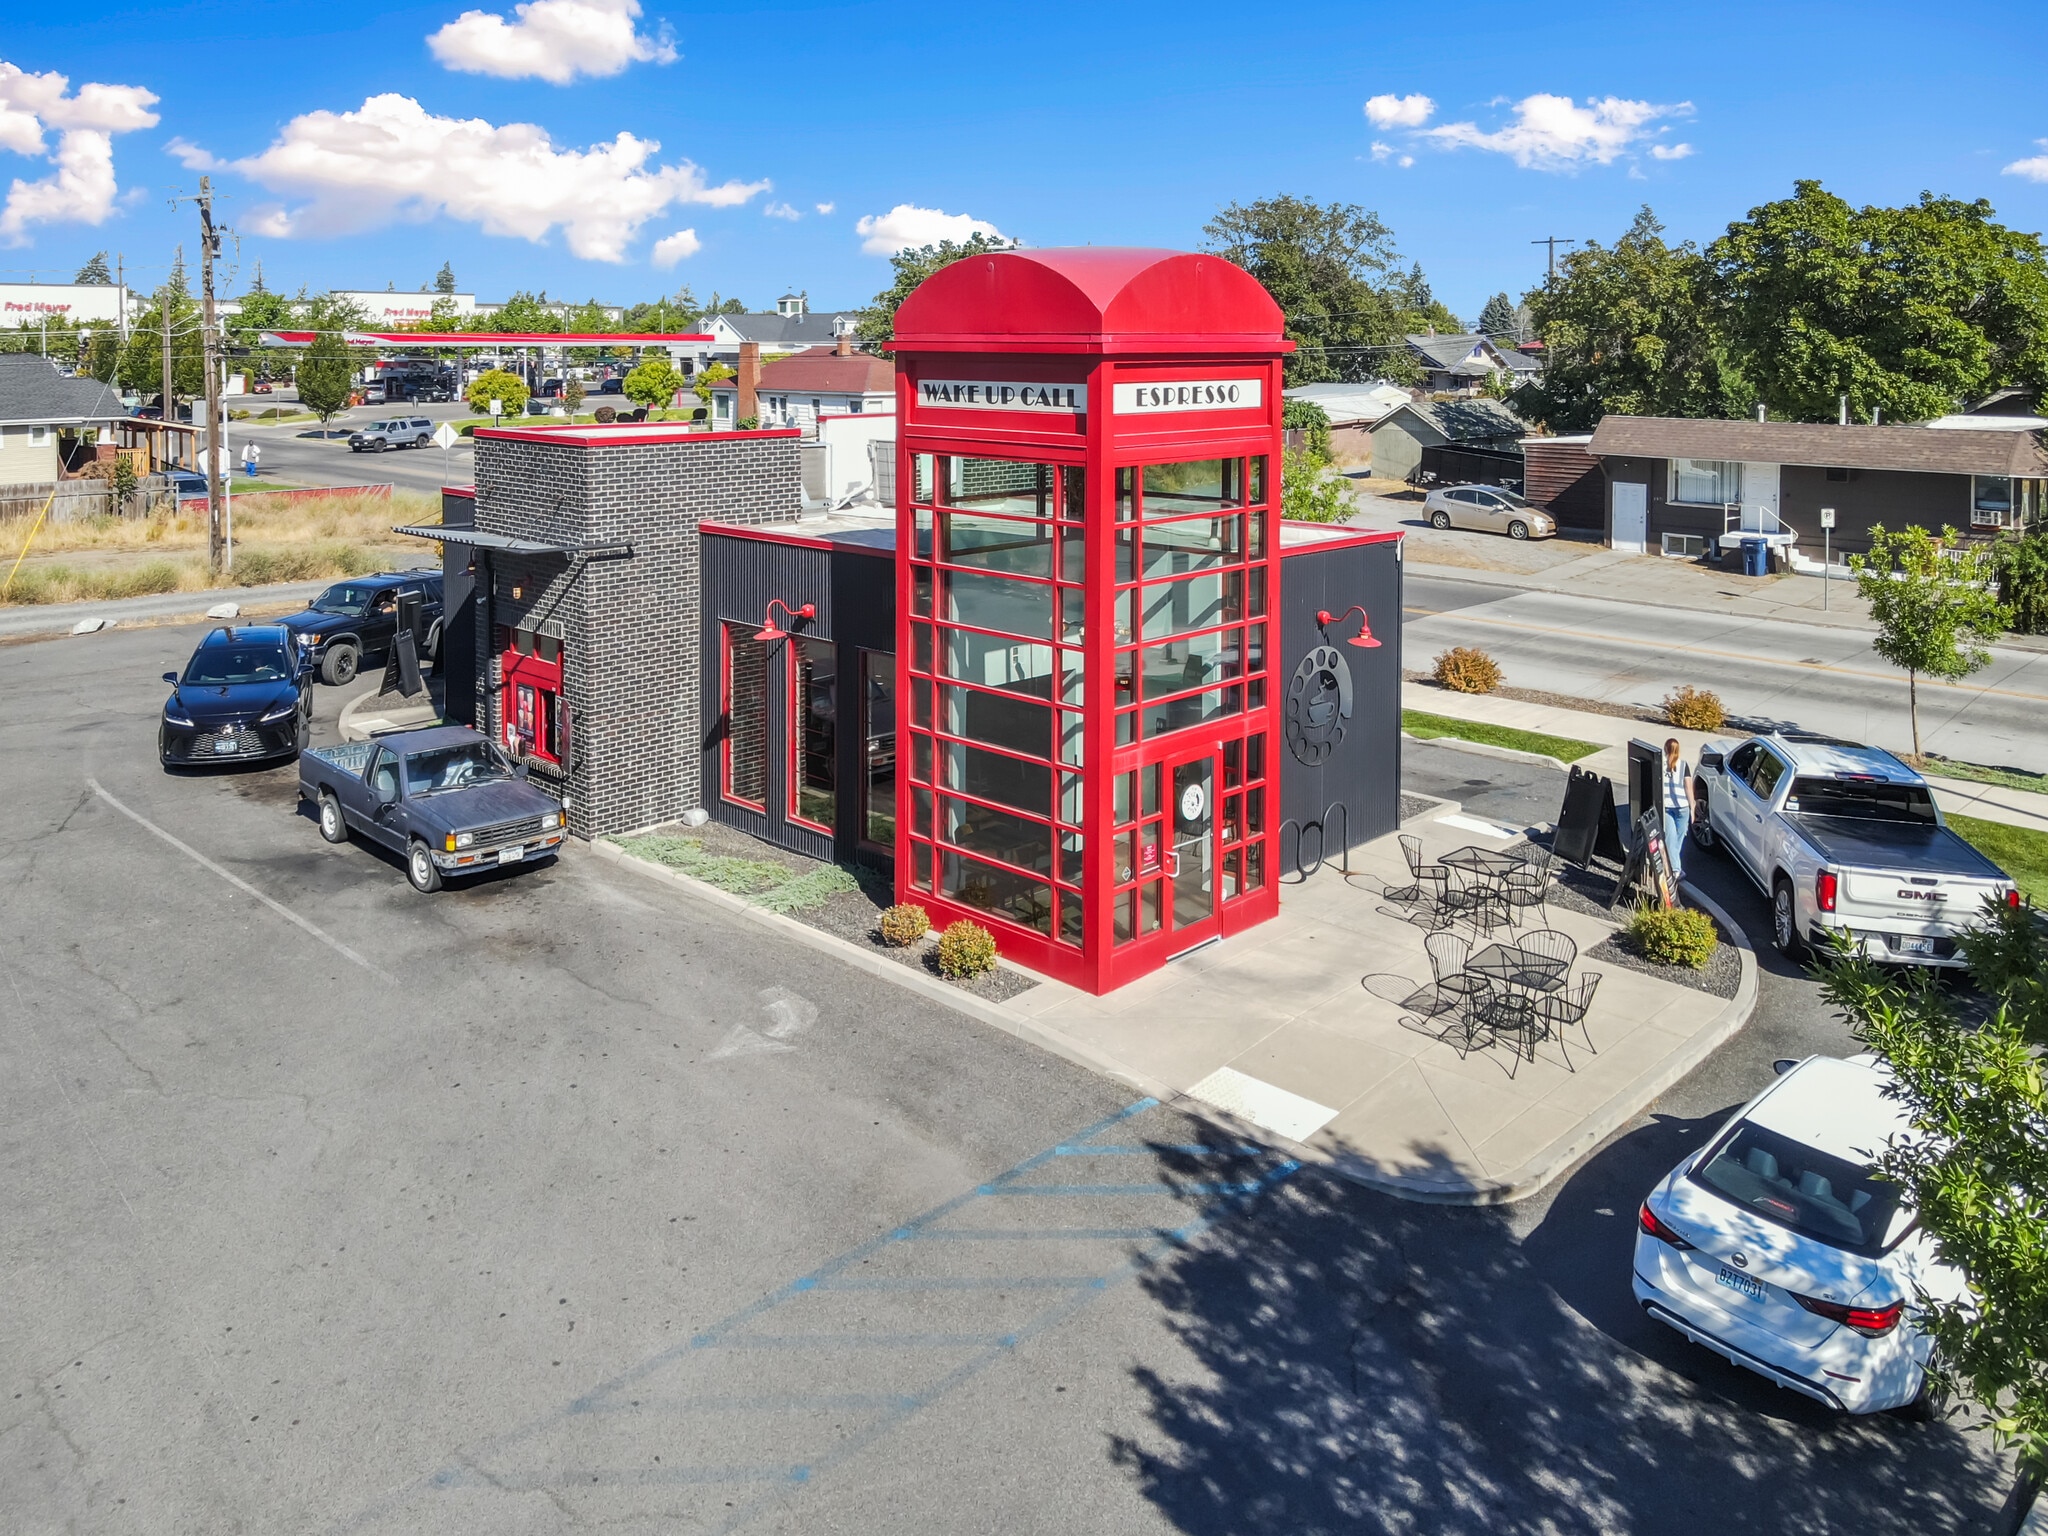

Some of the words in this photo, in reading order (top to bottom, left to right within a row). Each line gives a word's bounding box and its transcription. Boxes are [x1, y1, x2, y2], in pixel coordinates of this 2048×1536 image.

[4, 302, 32, 311] Fred
[384, 307, 404, 317] Fred
[406, 308, 431, 317] Meye
[923, 383, 980, 403] WAKE
[985, 385, 1015, 405] UP
[1020, 386, 1081, 408] CALL
[1136, 384, 1240, 407] ESPRESSO
[1897, 890, 1948, 902] GMC
[1719, 1268, 1762, 1299] BZT7031
